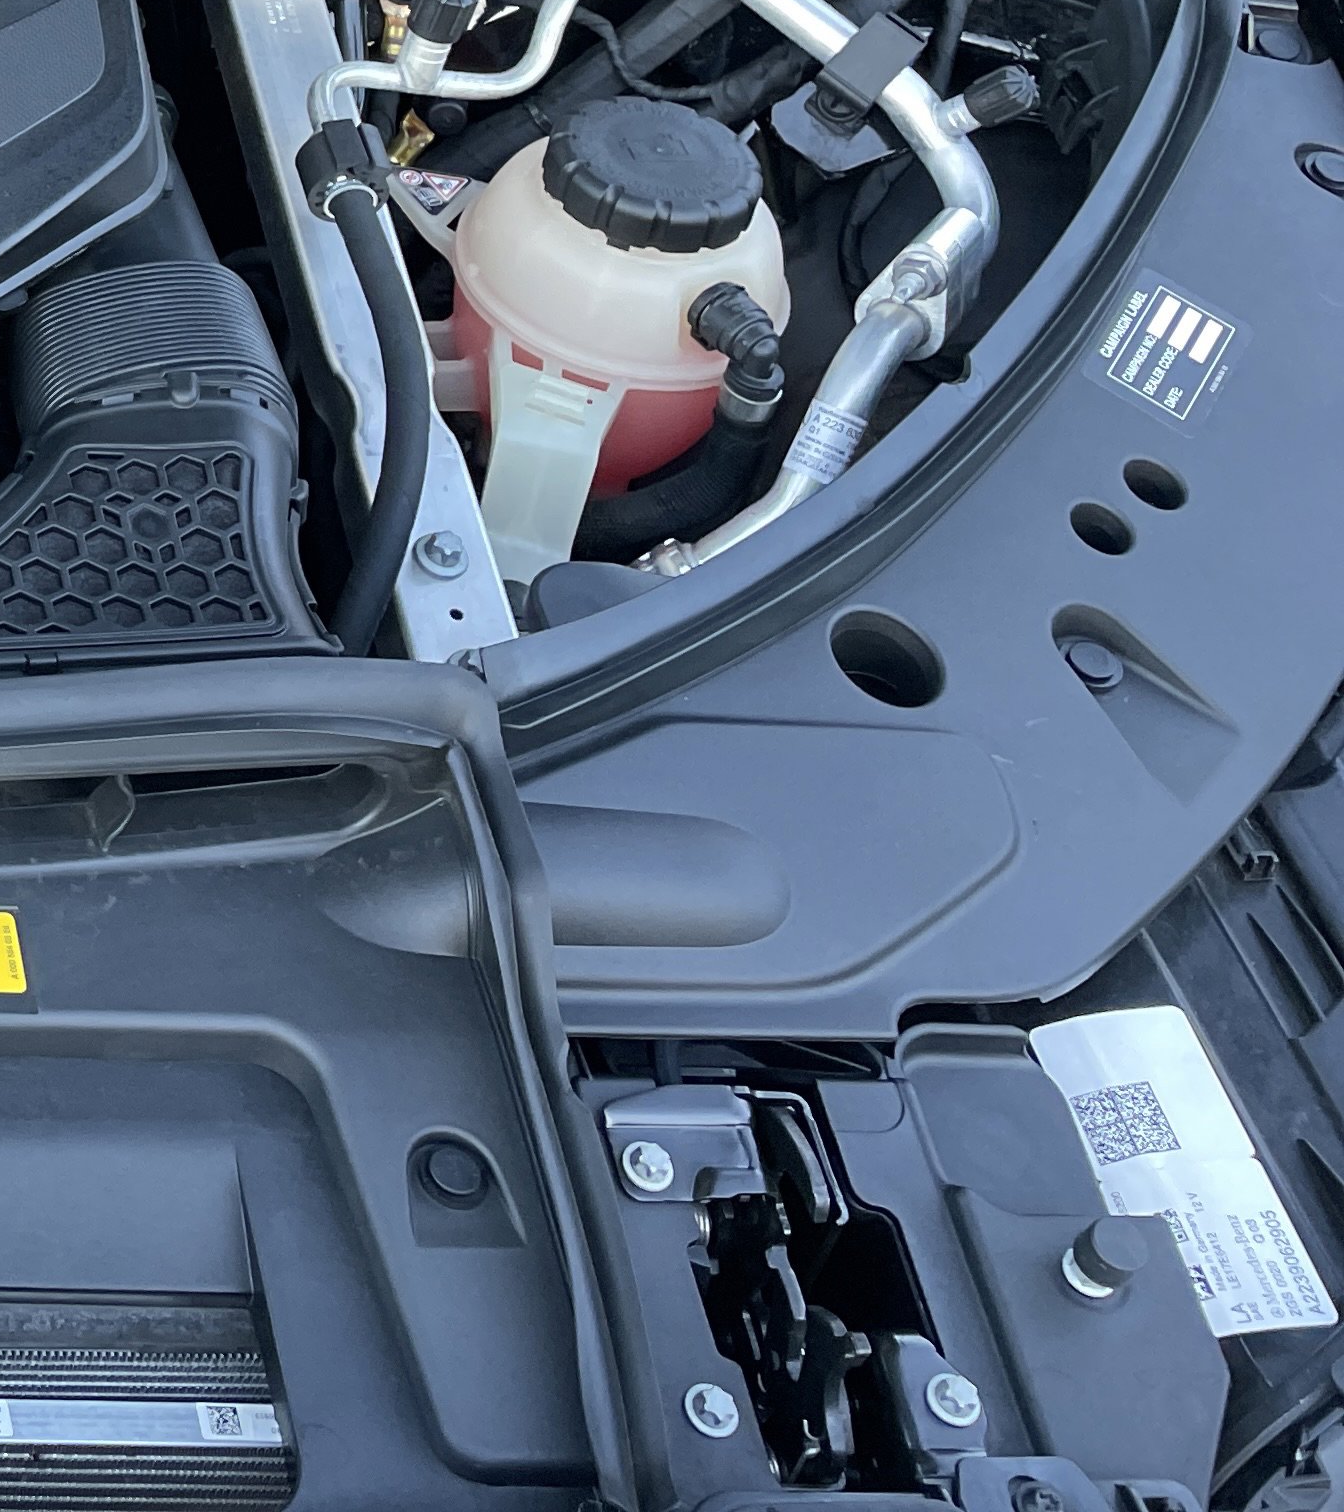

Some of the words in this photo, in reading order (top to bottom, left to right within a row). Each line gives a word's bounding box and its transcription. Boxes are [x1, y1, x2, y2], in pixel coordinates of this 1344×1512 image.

[1099, 313, 1134, 359] CAMPAIGN
[1124, 291, 1149, 318] LABEL
[1121, 345, 1151, 383] CAMPAIGN
[1142, 366, 1167, 397] DEALER
[1185, 1191, 1198, 1200] V
[1184, 1212, 1209, 1253] Germany
[1226, 1214, 1281, 1306] Mercedes-Benz
[1259, 1210, 1326, 1316] A2239062905
[1210, 1265, 1228, 1292] Made
[1230, 1302, 1253, 1324] LA
[1281, 1291, 1305, 1317] ZGS
